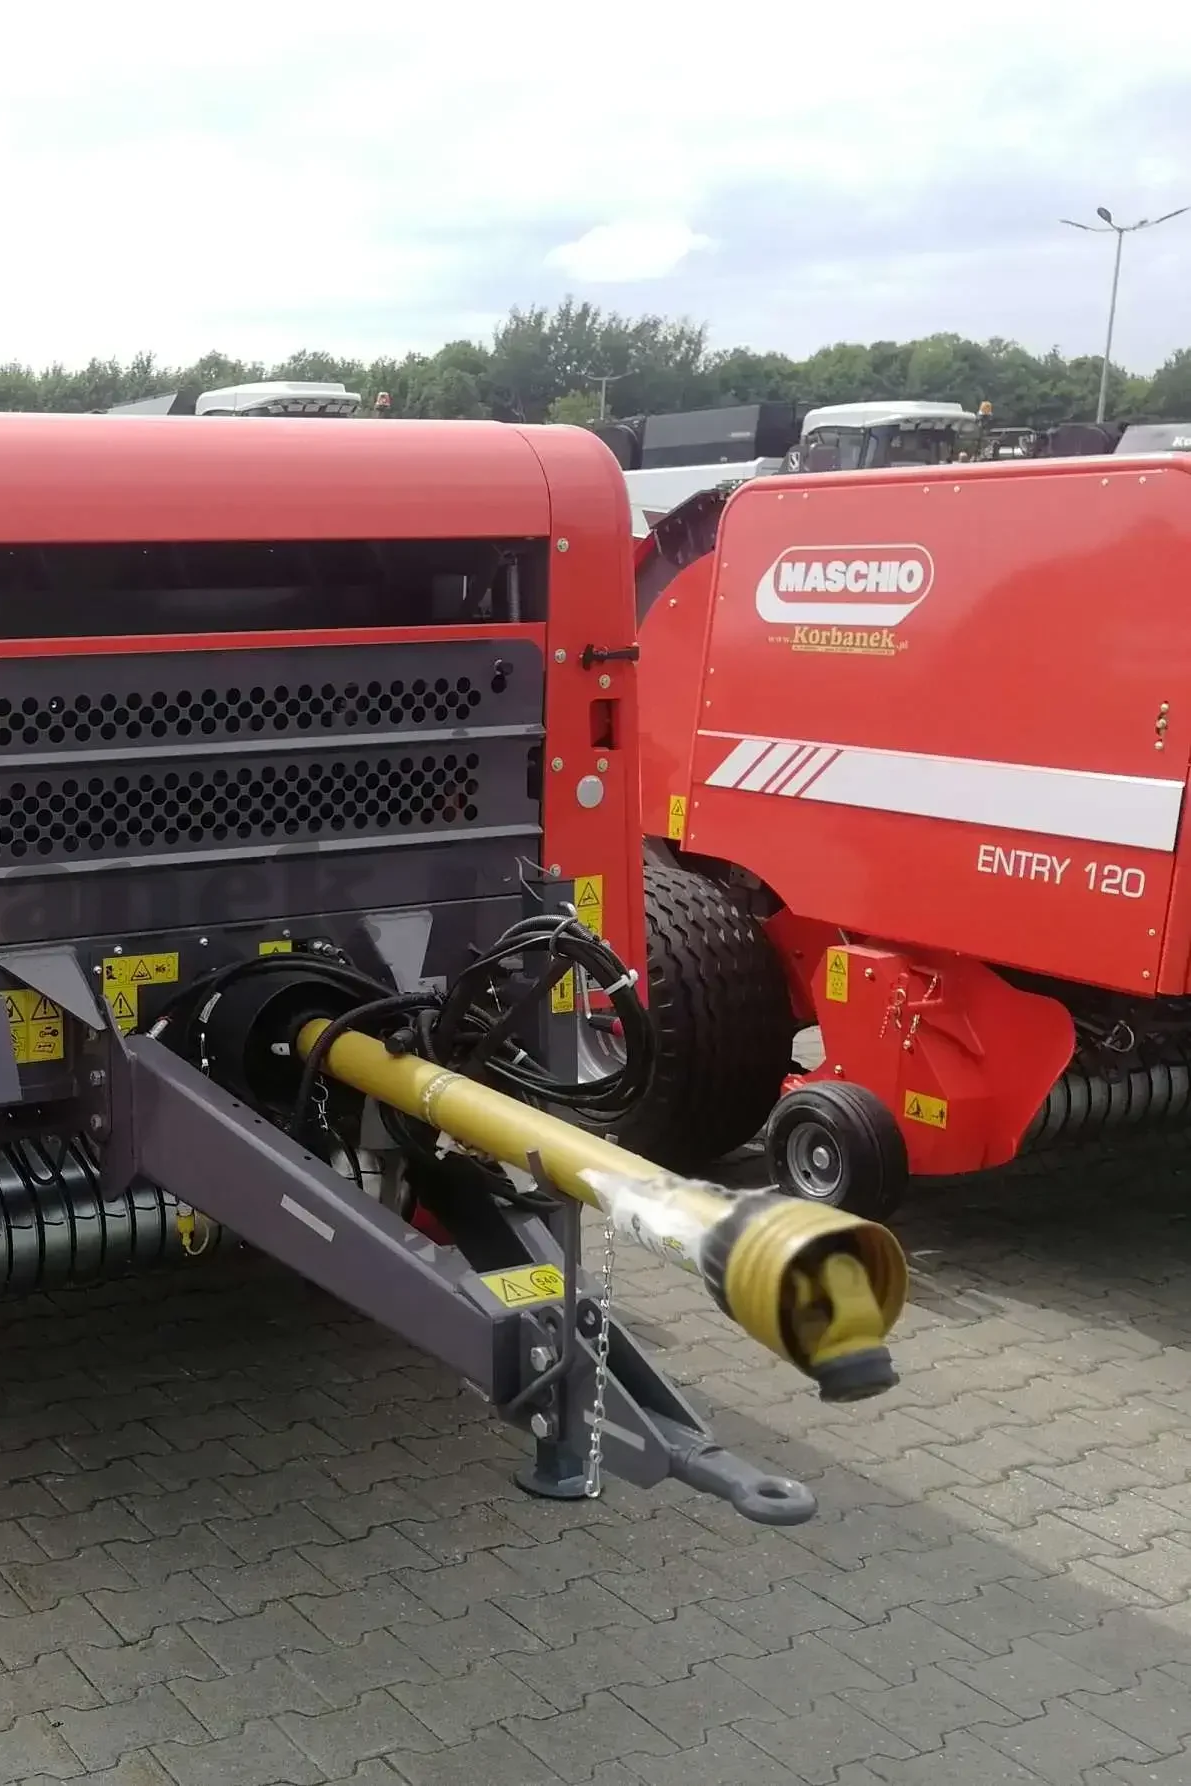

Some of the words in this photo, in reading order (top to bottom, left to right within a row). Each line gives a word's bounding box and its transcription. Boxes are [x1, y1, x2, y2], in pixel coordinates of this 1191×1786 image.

[778, 559, 925, 594] MASCHIO
[976, 843, 1072, 885] ENTRY
[1084, 861, 1146, 899] 120
[535, 1275, 559, 1286] 540
